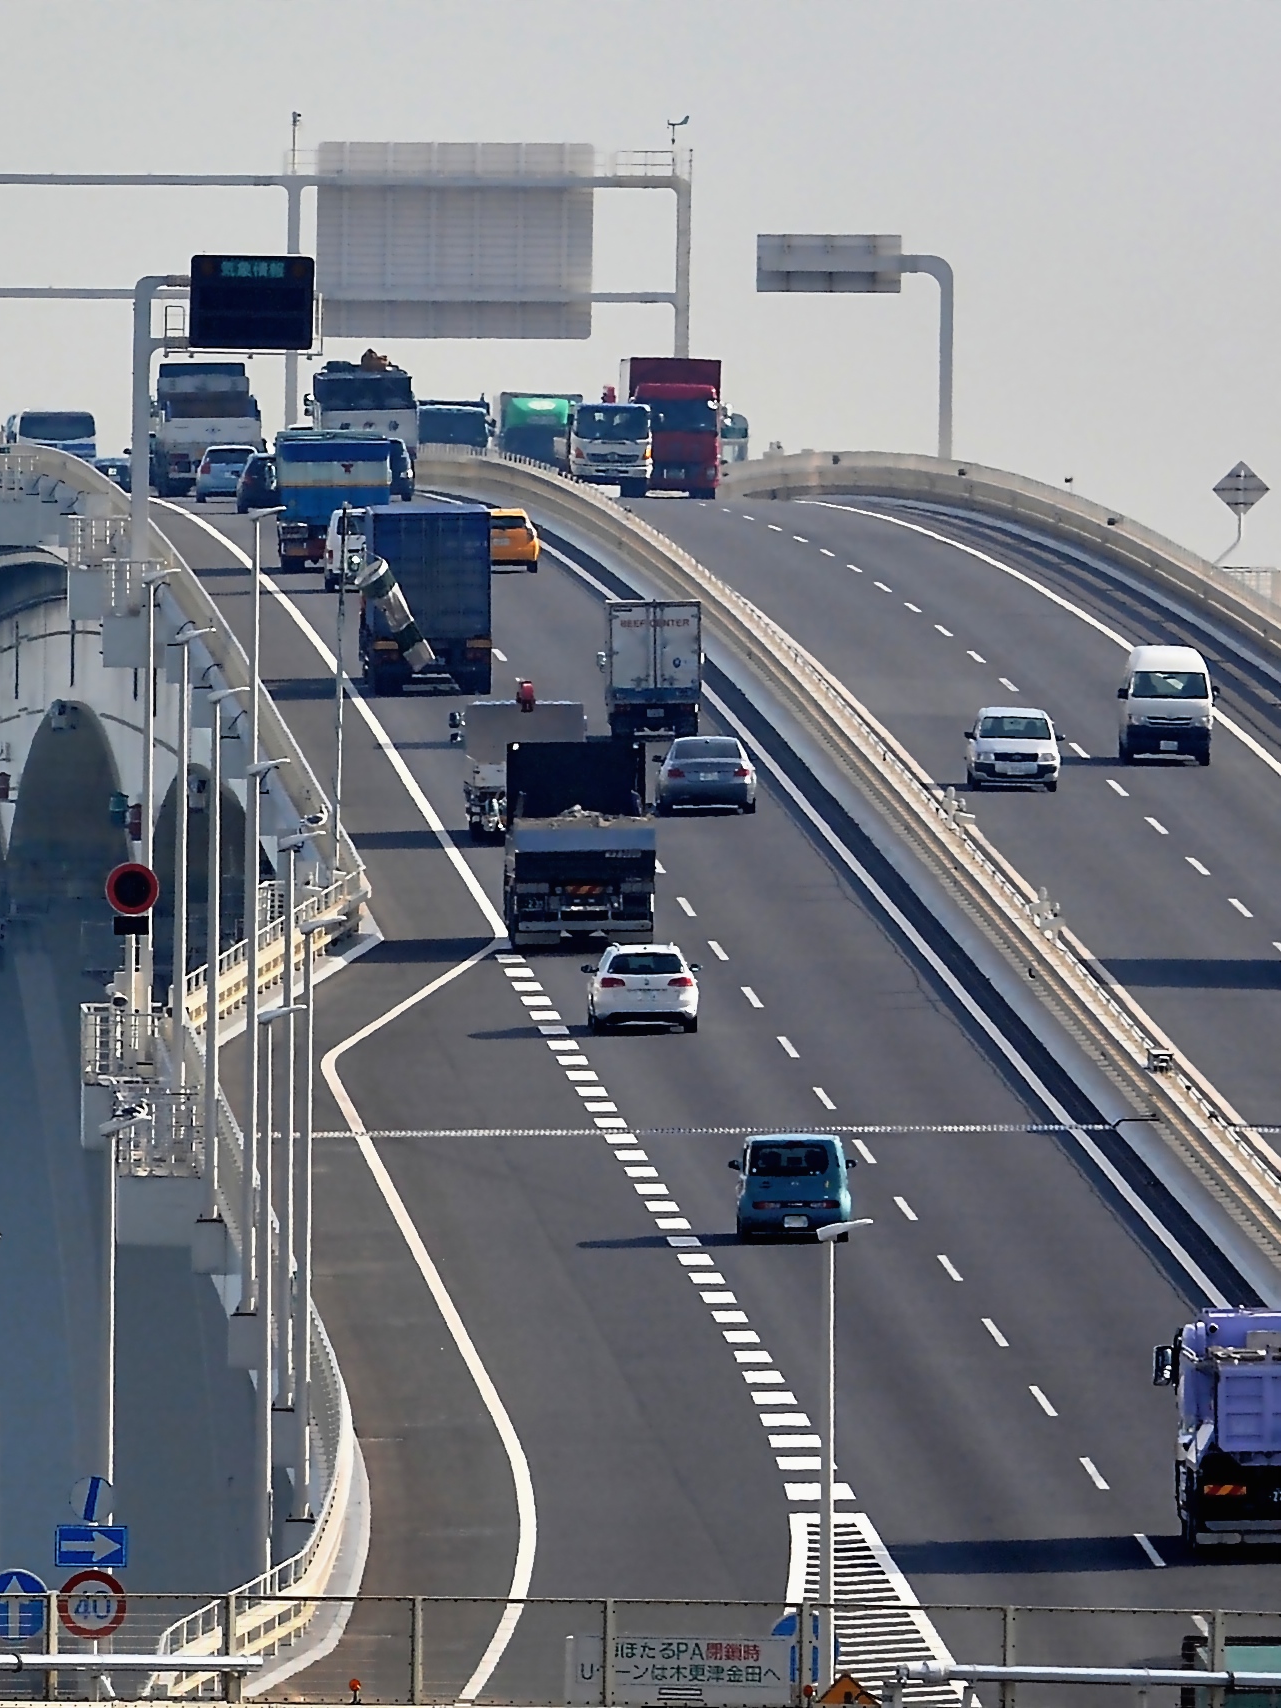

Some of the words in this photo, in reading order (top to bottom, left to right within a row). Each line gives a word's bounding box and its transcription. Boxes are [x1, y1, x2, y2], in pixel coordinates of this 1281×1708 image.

[621, 620, 645, 628] BEEF
[74, 1590, 111, 1620] 40
[615, 1642, 760, 1662] ほたるPA閉鎖時
[581, 1664, 781, 1683] Uーンは木更津金田へ
